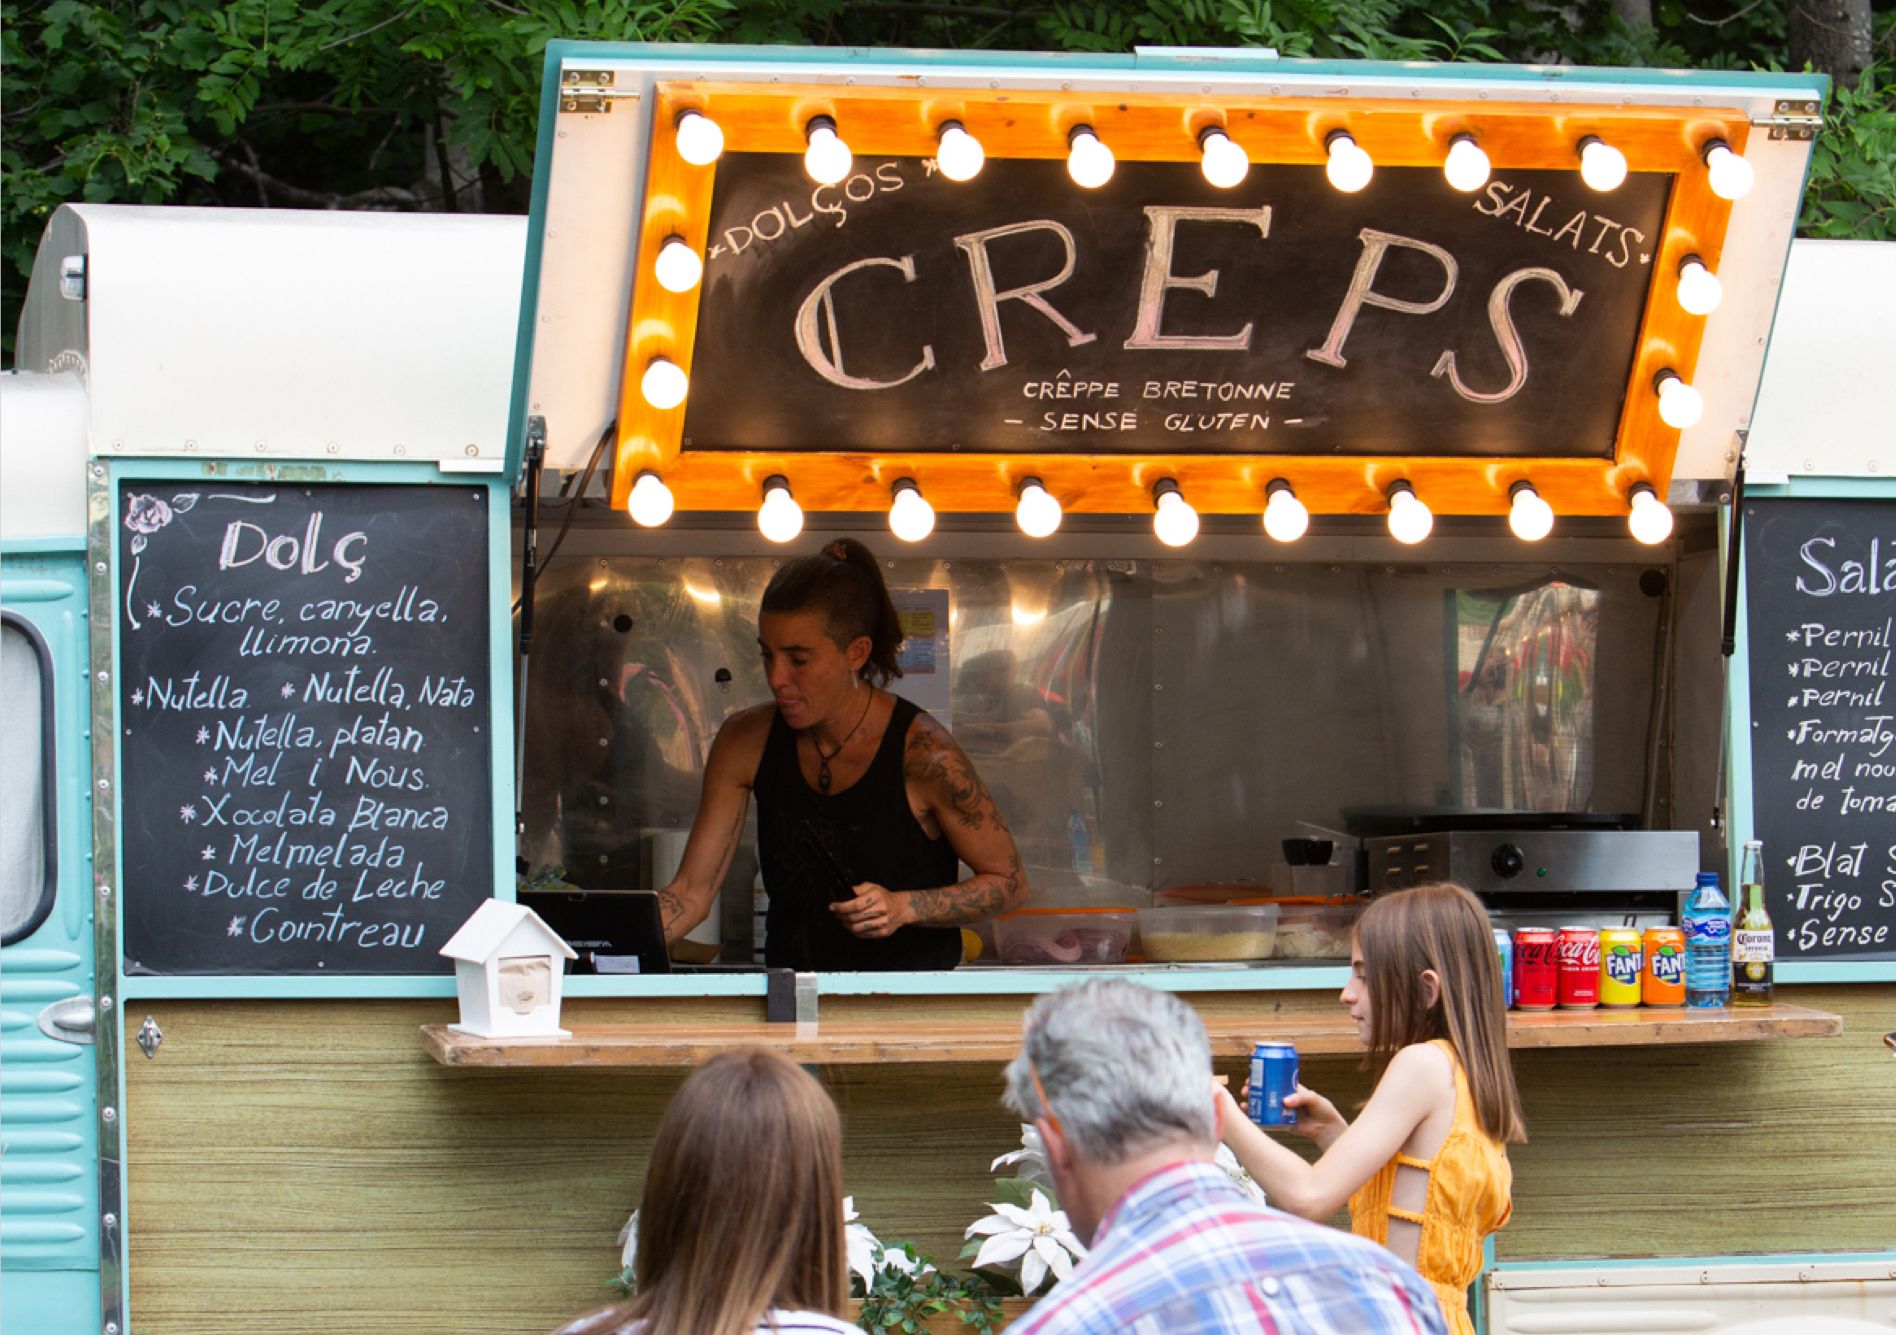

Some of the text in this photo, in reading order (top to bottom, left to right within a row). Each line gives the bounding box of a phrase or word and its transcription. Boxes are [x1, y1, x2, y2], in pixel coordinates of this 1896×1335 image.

[723, 161, 904, 255] DOLÇOS
[1473, 180, 1646, 269] SALATS
[794, 204, 1584, 404] CREPS
[1022, 368, 1296, 401] CRÊPPE BRETONNE
[1040, 411, 1271, 432] SENSE GLUTEN
[219, 510, 368, 584] Dolç
[1801, 617, 1893, 648] Pernil
[1801, 649, 1891, 678] Pernil
[418, 675, 475, 707] Nata
[1801, 681, 1886, 708] Pernil
[1796, 715, 1896, 758] Formatg
[221, 752, 278, 788] Mel
[308, 757, 322, 787] i
[1791, 752, 1896, 781] mel nou
[201, 791, 449, 833] Xocolata Blanca
[1796, 785, 1896, 815] de toma
[228, 831, 405, 869] Melmelada
[1795, 841, 1869, 879] Blat
[201, 862, 446, 902] Dulce de Leche
[1796, 883, 1862, 922] Trigo
[250, 903, 425, 948] Cointreau
[1799, 918, 1889, 950] Sense
[1606, 952, 1643, 976] FANT
[1652, 952, 1686, 976] FANT
